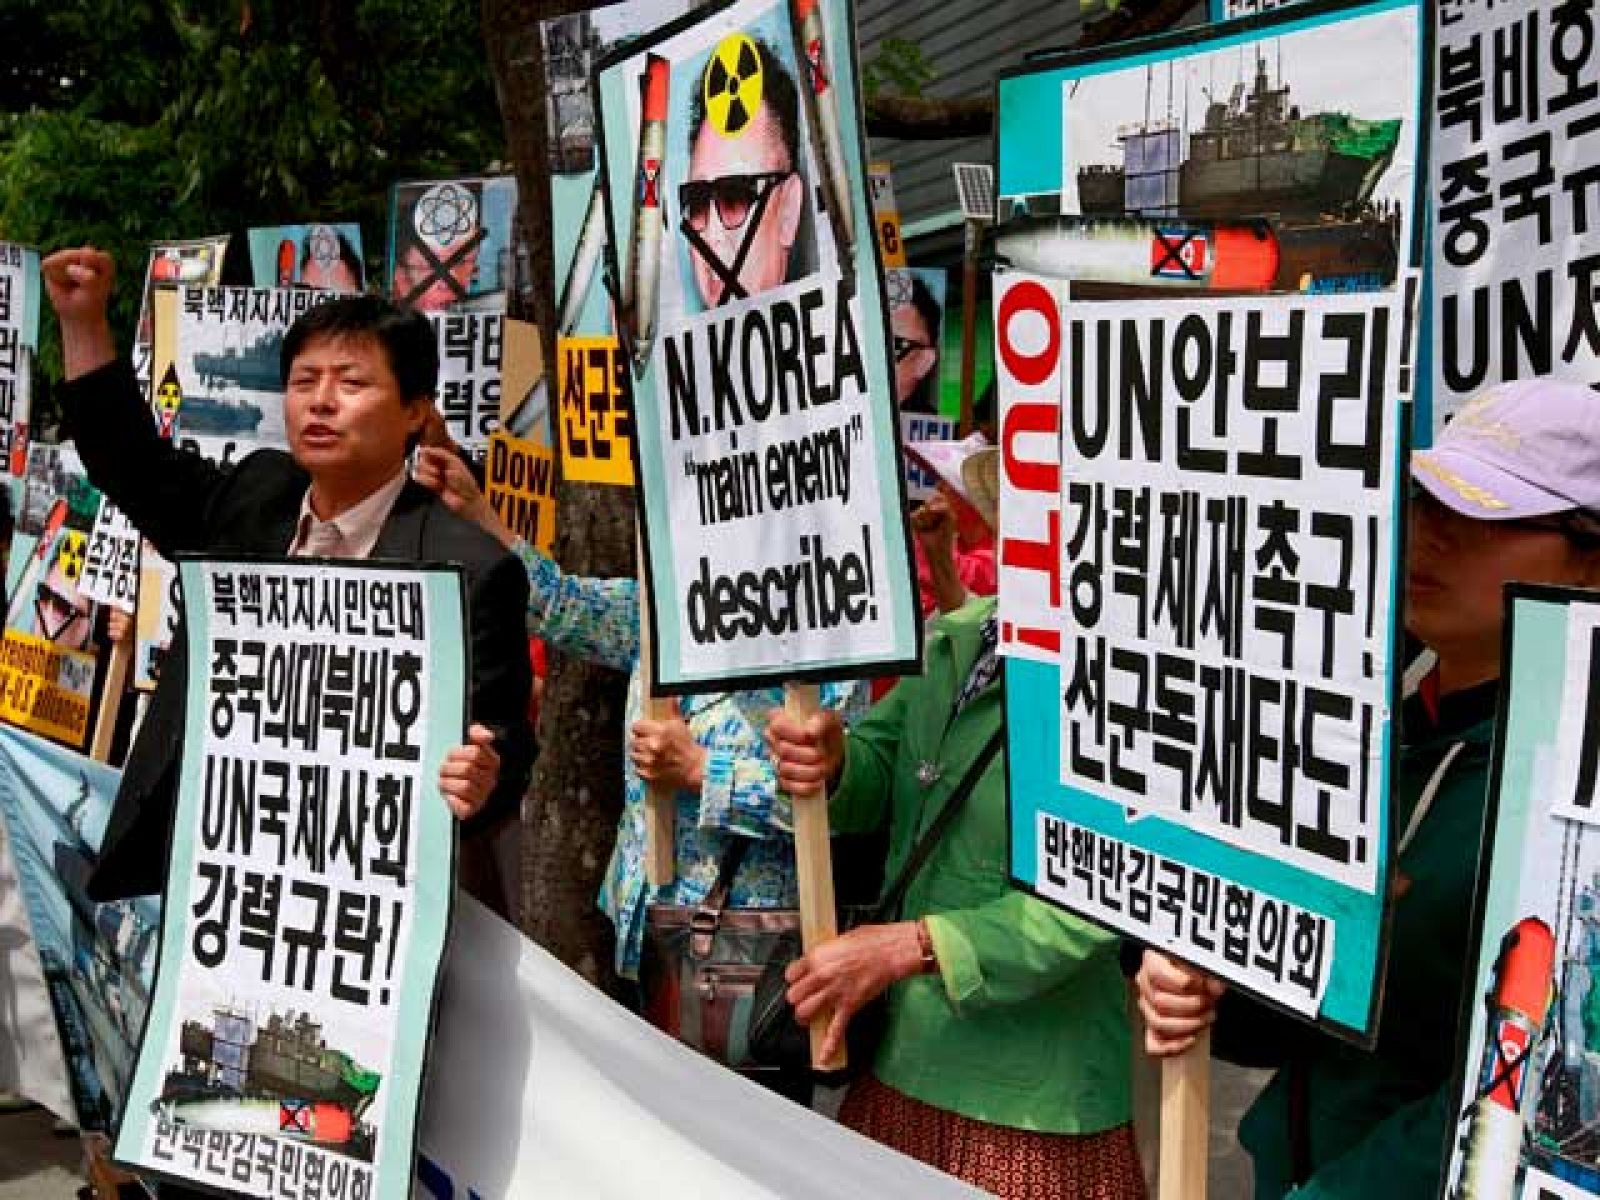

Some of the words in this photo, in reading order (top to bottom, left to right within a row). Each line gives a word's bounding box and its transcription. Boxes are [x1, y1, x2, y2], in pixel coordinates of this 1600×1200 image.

[997, 280, 1061, 653] OUT!
[1070, 306, 1390, 489] UN안보리
[211, 572, 425, 640] 북핵저지시민연대
[687, 524, 878, 645] describe!
[1067, 482, 1378, 678] 강력제재촉구!
[210, 639, 423, 760] 중국의대북비호
[1064, 636, 1371, 864] 선군독재타도!
[201, 755, 413, 887] UN국제사회
[192, 862, 403, 1005] 강력규탄!
[1044, 817, 1326, 998] 반핵반김국민협의회
